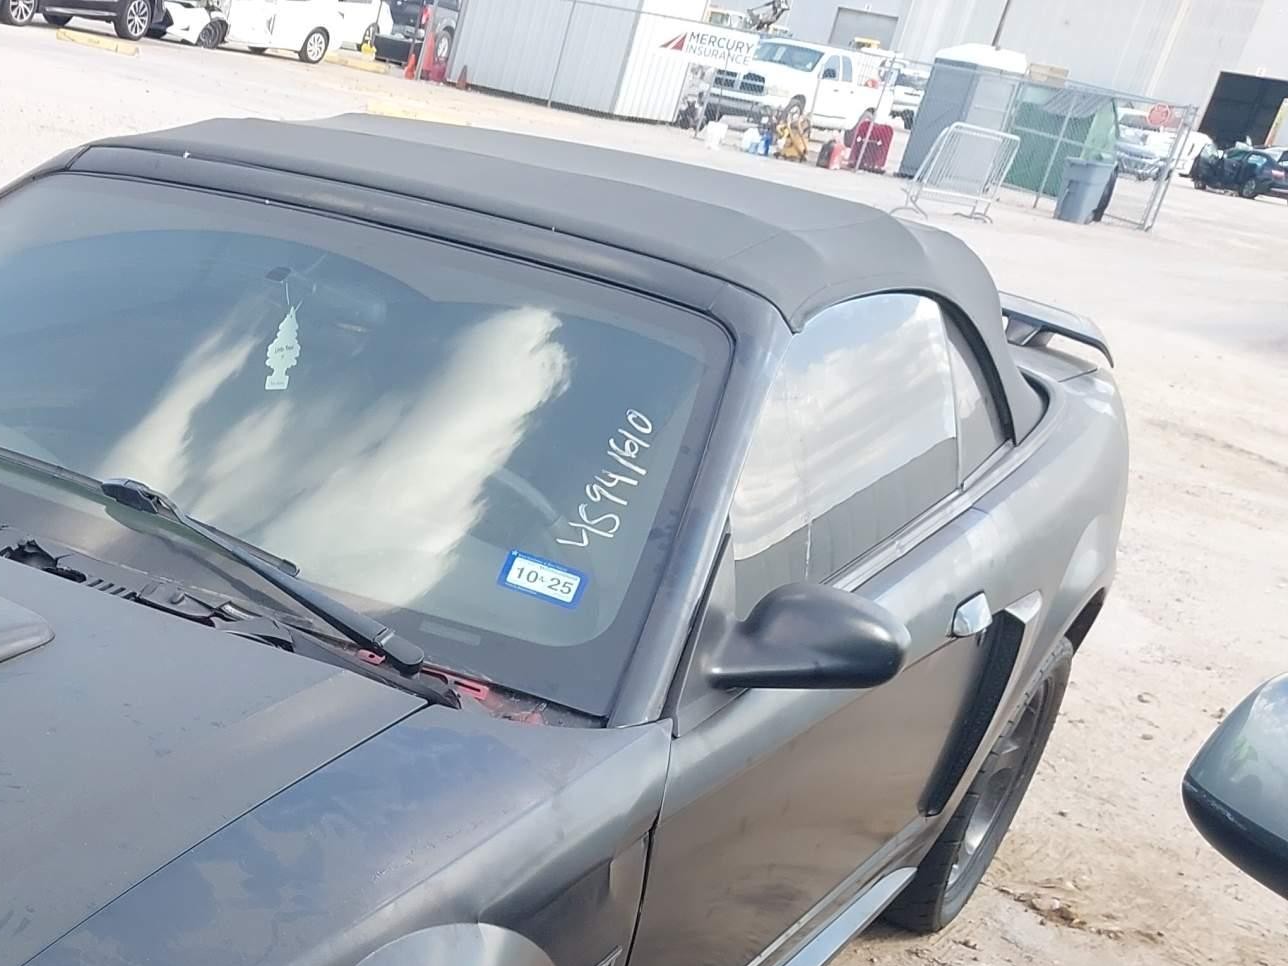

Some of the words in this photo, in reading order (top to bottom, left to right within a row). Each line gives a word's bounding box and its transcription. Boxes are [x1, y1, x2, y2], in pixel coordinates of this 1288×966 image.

[689, 31, 754, 54] MERCURY
[685, 43, 751, 66] INSURANCE
[556, 408, 652, 547] 45941610
